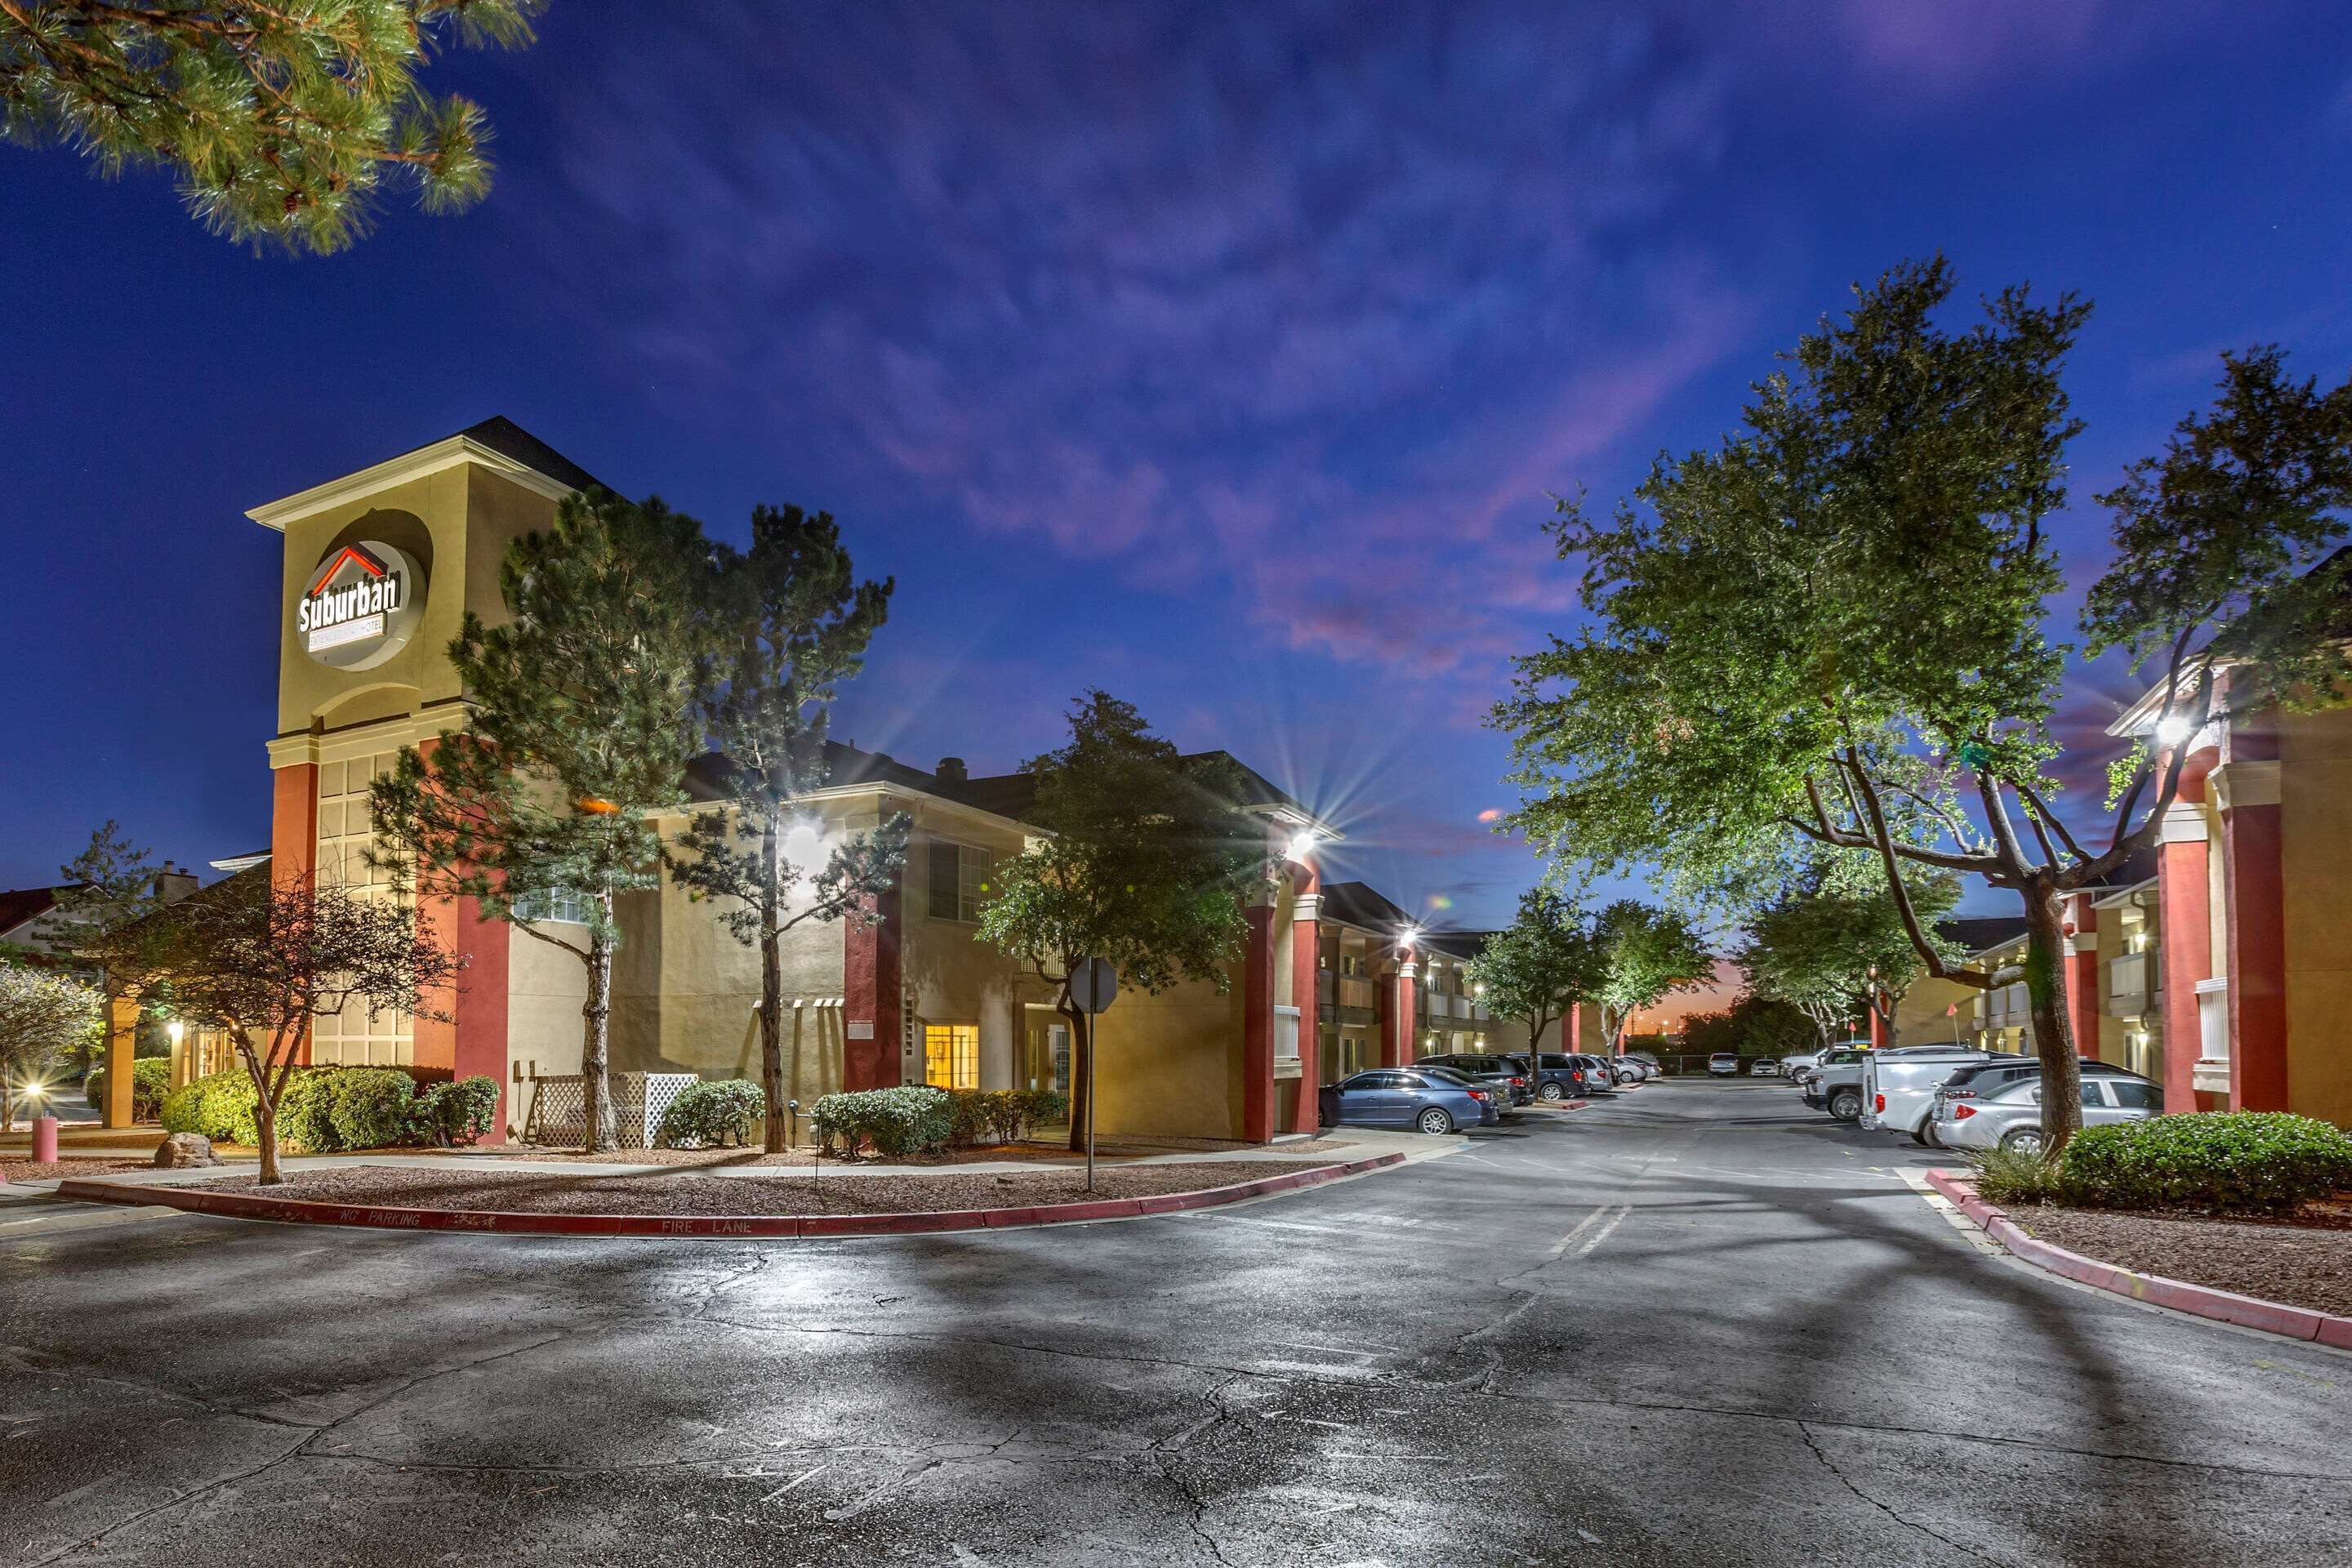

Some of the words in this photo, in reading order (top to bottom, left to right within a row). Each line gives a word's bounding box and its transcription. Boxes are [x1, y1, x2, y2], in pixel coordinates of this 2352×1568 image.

[300, 579, 396, 632] Suburban
[341, 1209, 359, 1221] NO
[368, 1210, 421, 1226] PARKING
[662, 1220, 693, 1233] FIRE
[712, 1220, 751, 1233] LANE
